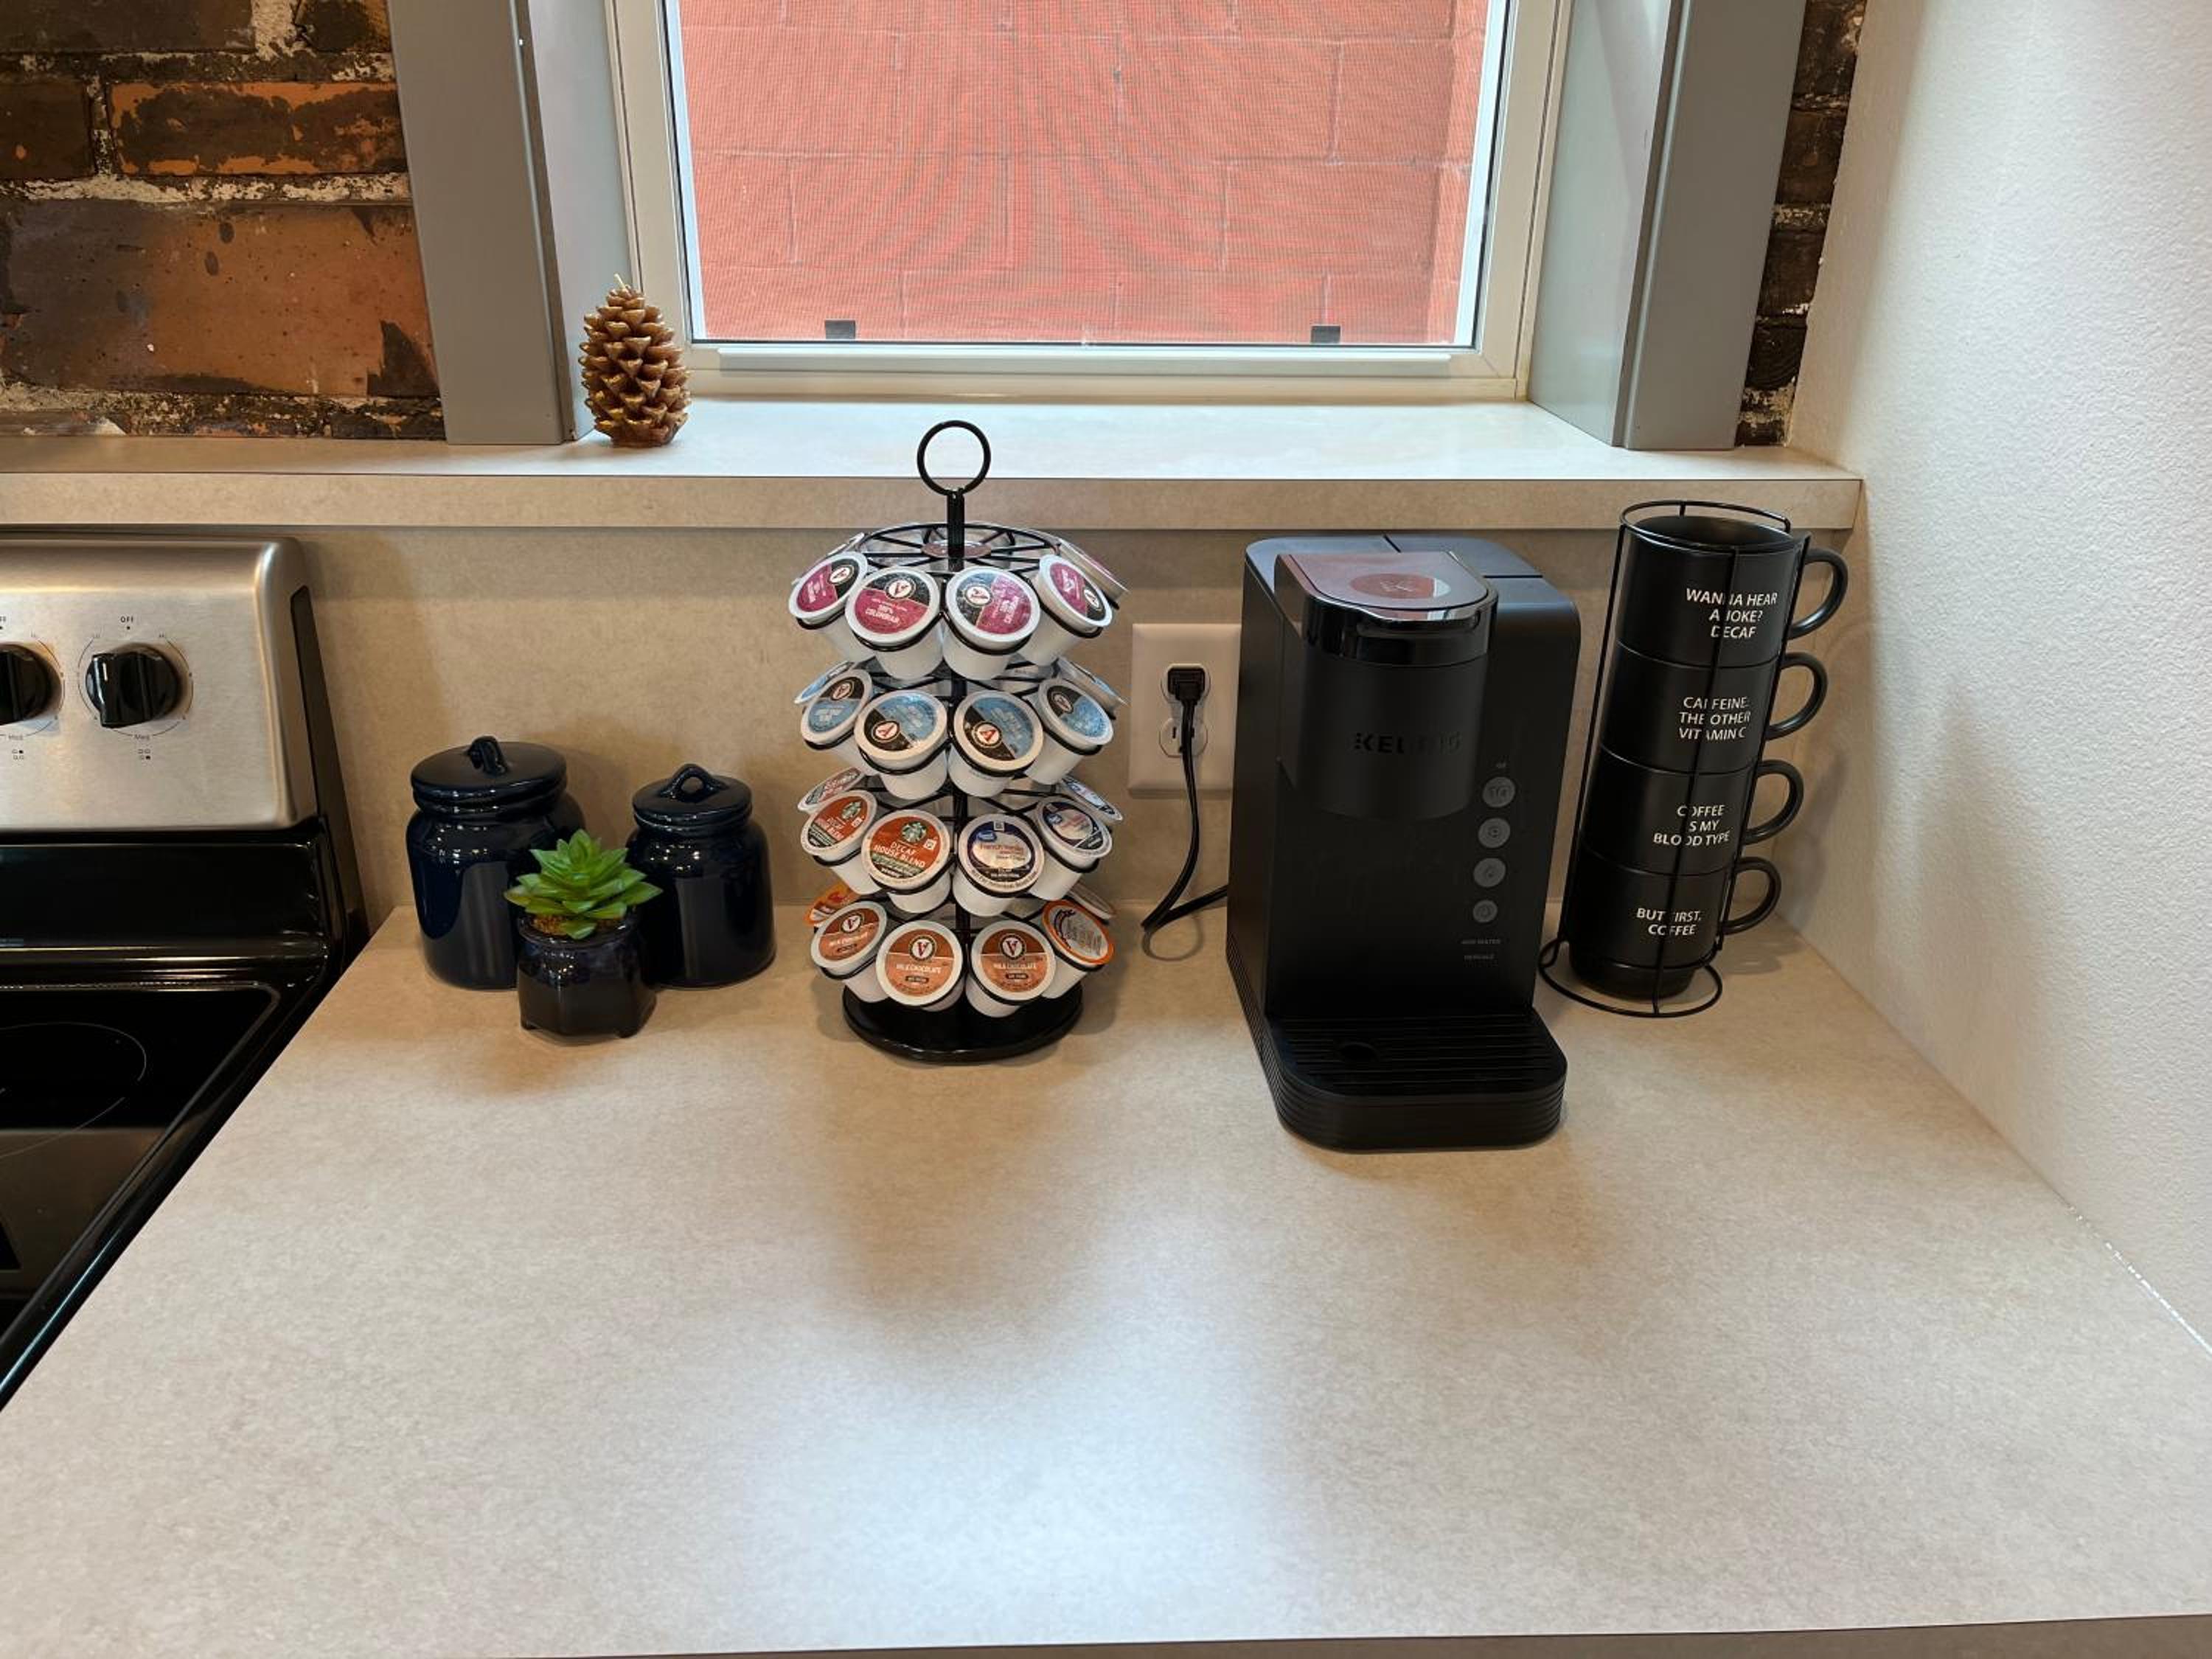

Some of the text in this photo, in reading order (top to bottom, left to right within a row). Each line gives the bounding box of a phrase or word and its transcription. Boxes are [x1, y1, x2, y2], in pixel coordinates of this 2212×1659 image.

[1747, 592, 1778, 606] HEAR
[1708, 608, 1720, 621] A
[1711, 625, 1756, 639] DECAF
[1679, 711, 1750, 725] THE OTHER
[1738, 726, 1746, 737] C
[1354, 732, 1461, 754] KEUIG
[1700, 820, 1719, 832] MY
[1705, 830, 1731, 846] TYPE
[1636, 908, 1702, 922] BUT IRST,
